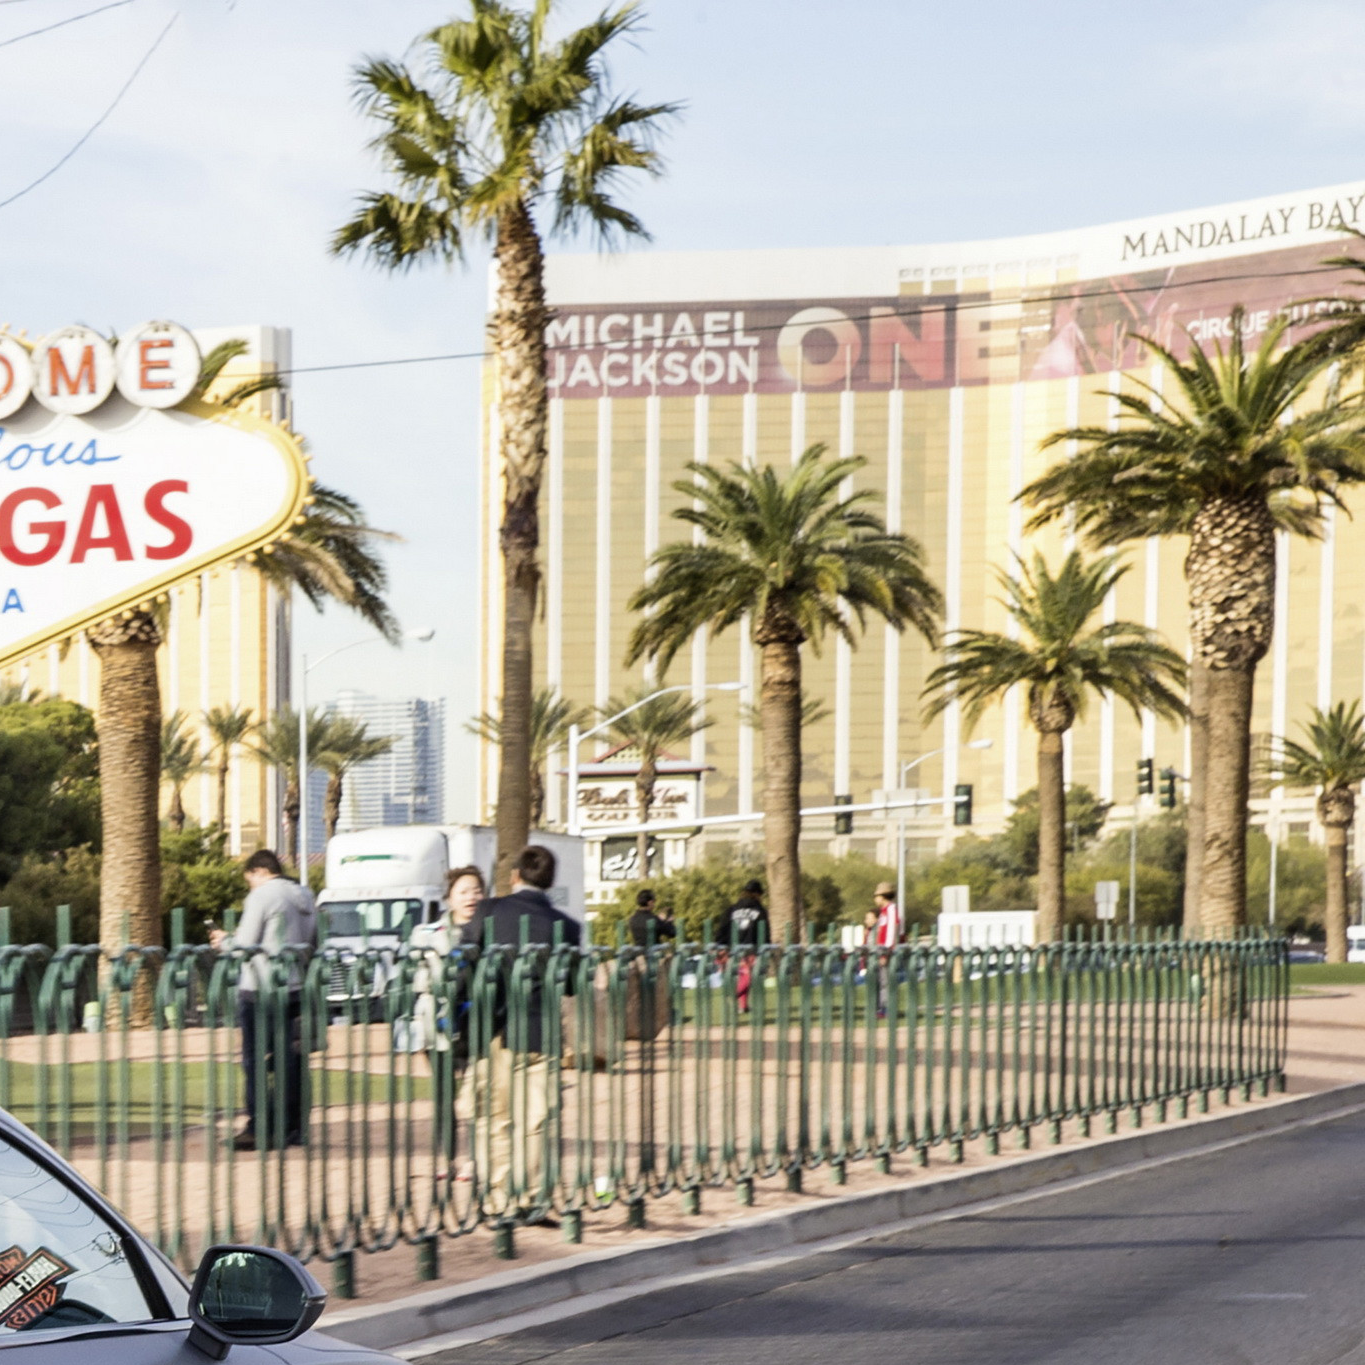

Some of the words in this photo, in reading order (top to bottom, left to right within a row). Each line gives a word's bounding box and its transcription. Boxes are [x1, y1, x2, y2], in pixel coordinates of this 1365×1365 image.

[1121, 206, 1296, 261] MANDALAY
[1307, 194, 1365, 231] BAY
[545, 311, 760, 349] MICHAEL
[545, 351, 759, 388] JACKSON
